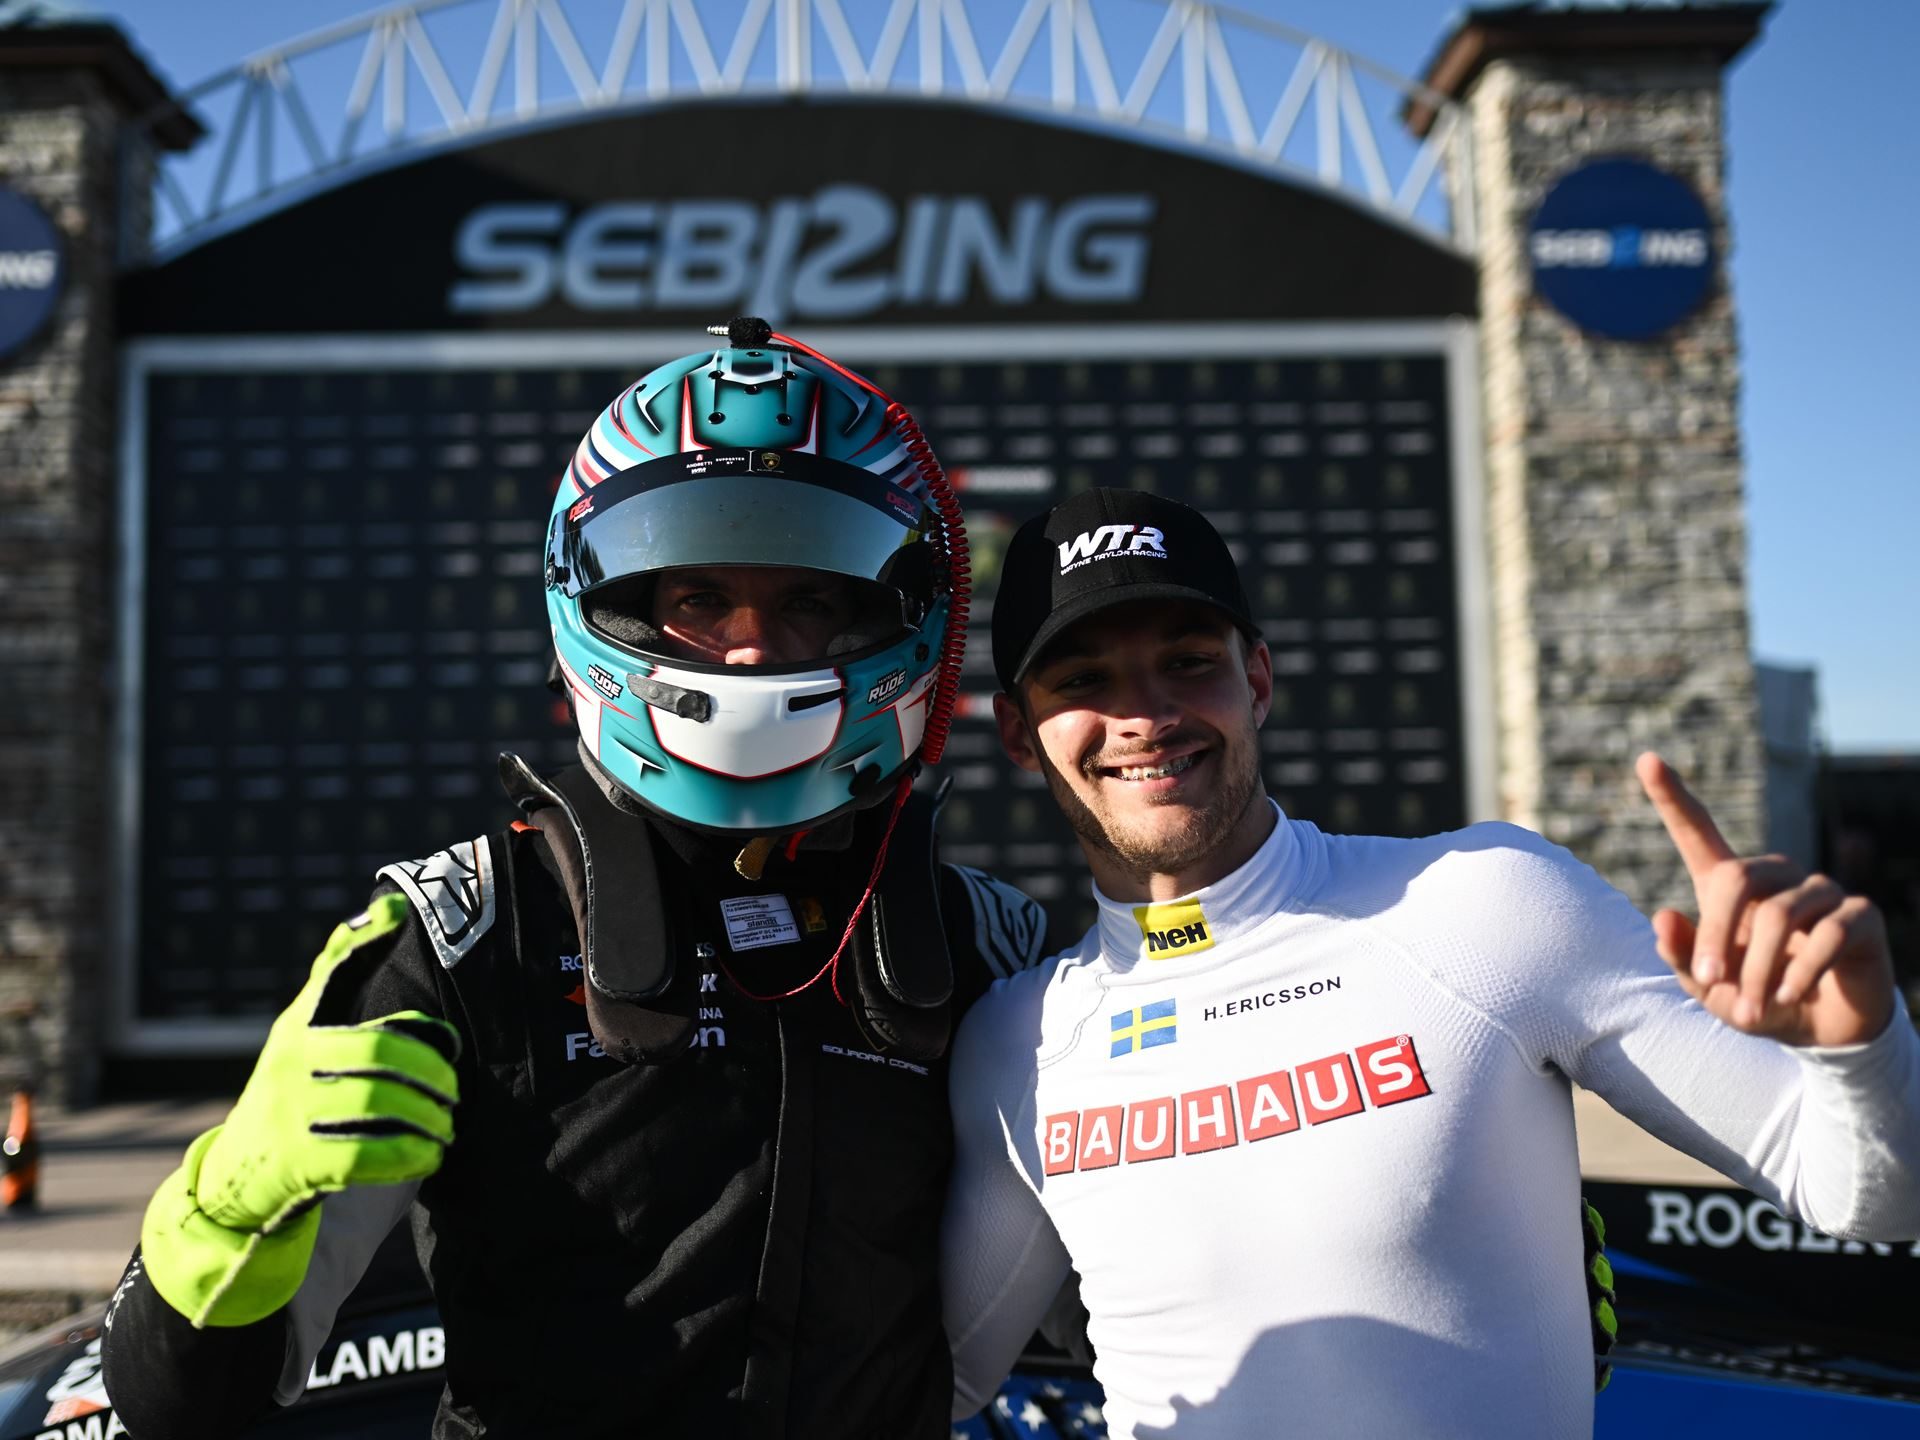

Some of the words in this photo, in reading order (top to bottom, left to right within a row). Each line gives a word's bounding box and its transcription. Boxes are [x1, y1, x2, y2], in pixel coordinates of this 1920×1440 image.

[1058, 525, 1167, 568] WTR
[1060, 557, 1092, 576] WAYNE
[1094, 550, 1130, 562] TAYLOR
[1132, 550, 1168, 559] RACING
[588, 666, 623, 697] RUDE
[868, 671, 907, 703] RUDE
[1147, 921, 1208, 952] NeH
[1204, 976, 1341, 1021] H.ERICSSON
[822, 1044, 886, 1064] SQUADRA
